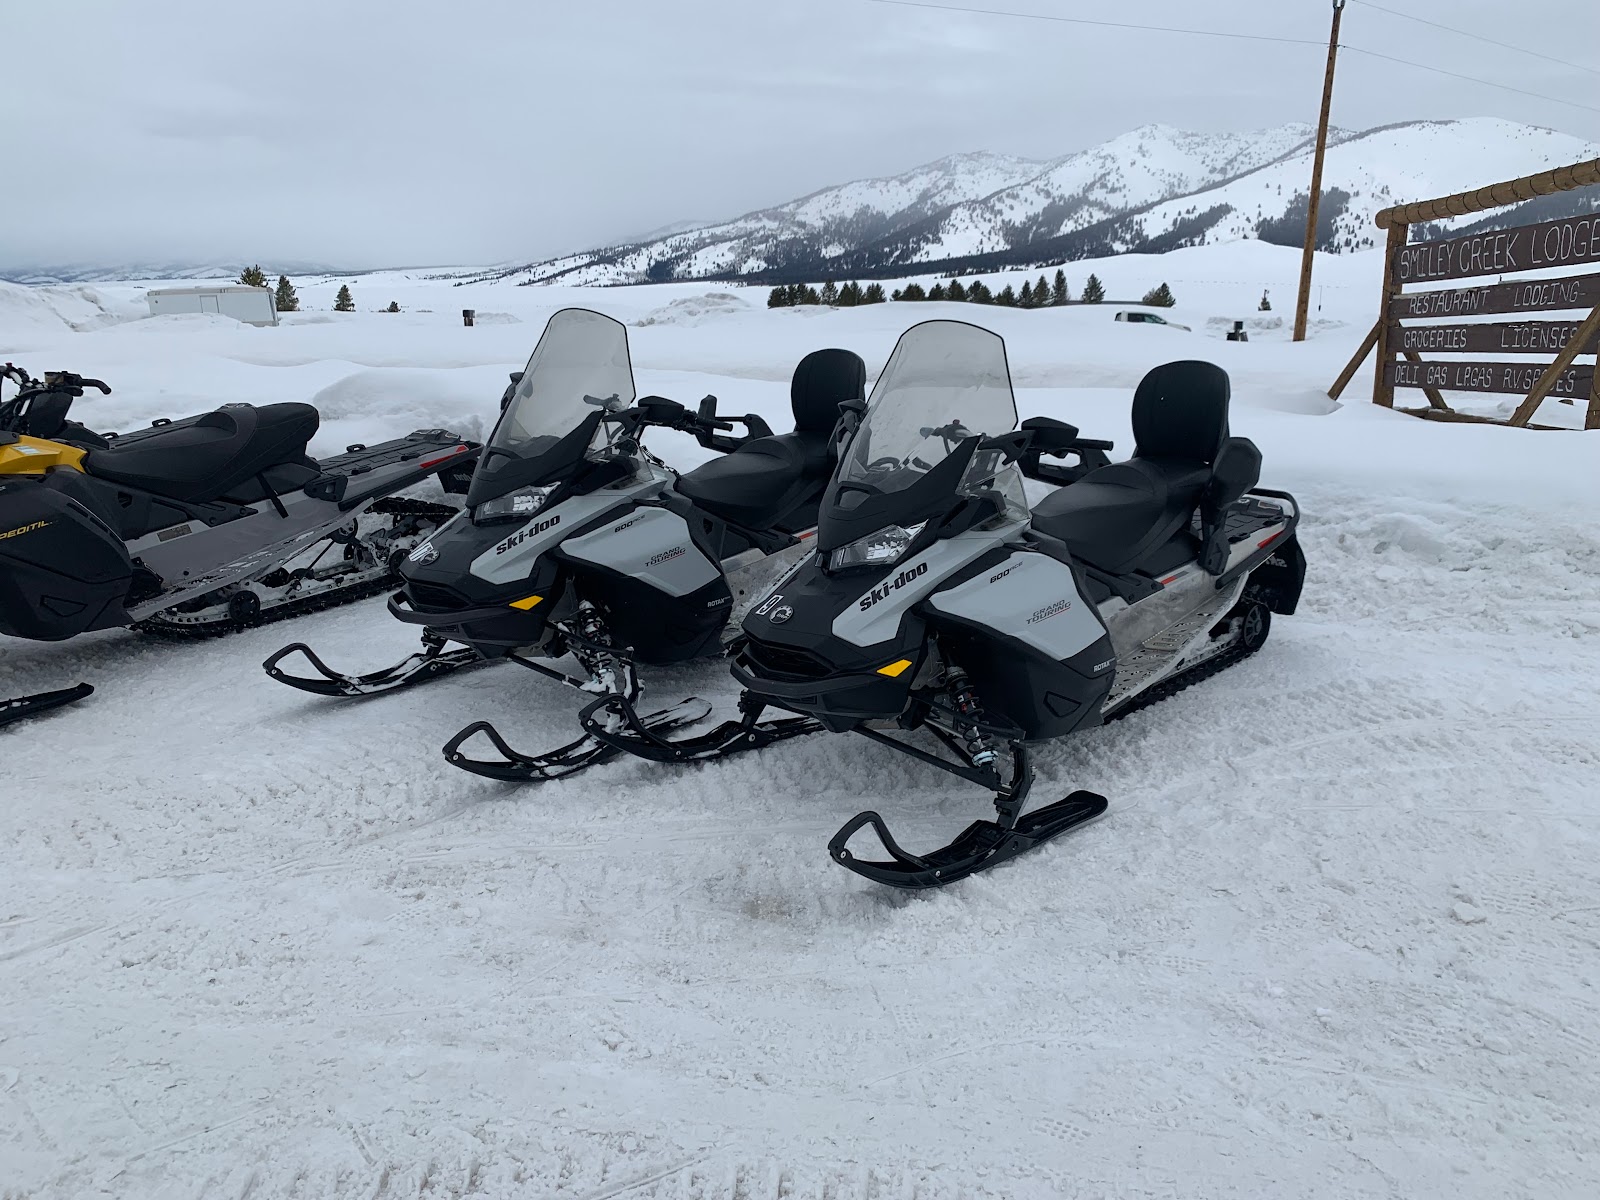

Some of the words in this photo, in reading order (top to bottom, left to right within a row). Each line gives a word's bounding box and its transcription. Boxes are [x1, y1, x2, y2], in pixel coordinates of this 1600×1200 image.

[1401, 244, 1456, 279] SMILEY
[1460, 232, 1520, 273] CREEK
[1531, 218, 1600, 264] LODGE
[1408, 289, 1491, 315] RESTAURANT
[1403, 328, 1467, 349] GROCERIES
[1394, 365, 1420, 385] DELI
[1426, 366, 1448, 386] GAS
[1522, 368, 1576, 393] SPES
[644, 548, 687, 567] TOURING
[650, 546, 680, 561] GRAND
[989, 568, 1010, 584] 600
[707, 597, 725, 608] ROTAX
[1032, 599, 1066, 617] GRAND
[1025, 602, 1072, 625] TOURING
[1093, 660, 1110, 673] ROTAX
